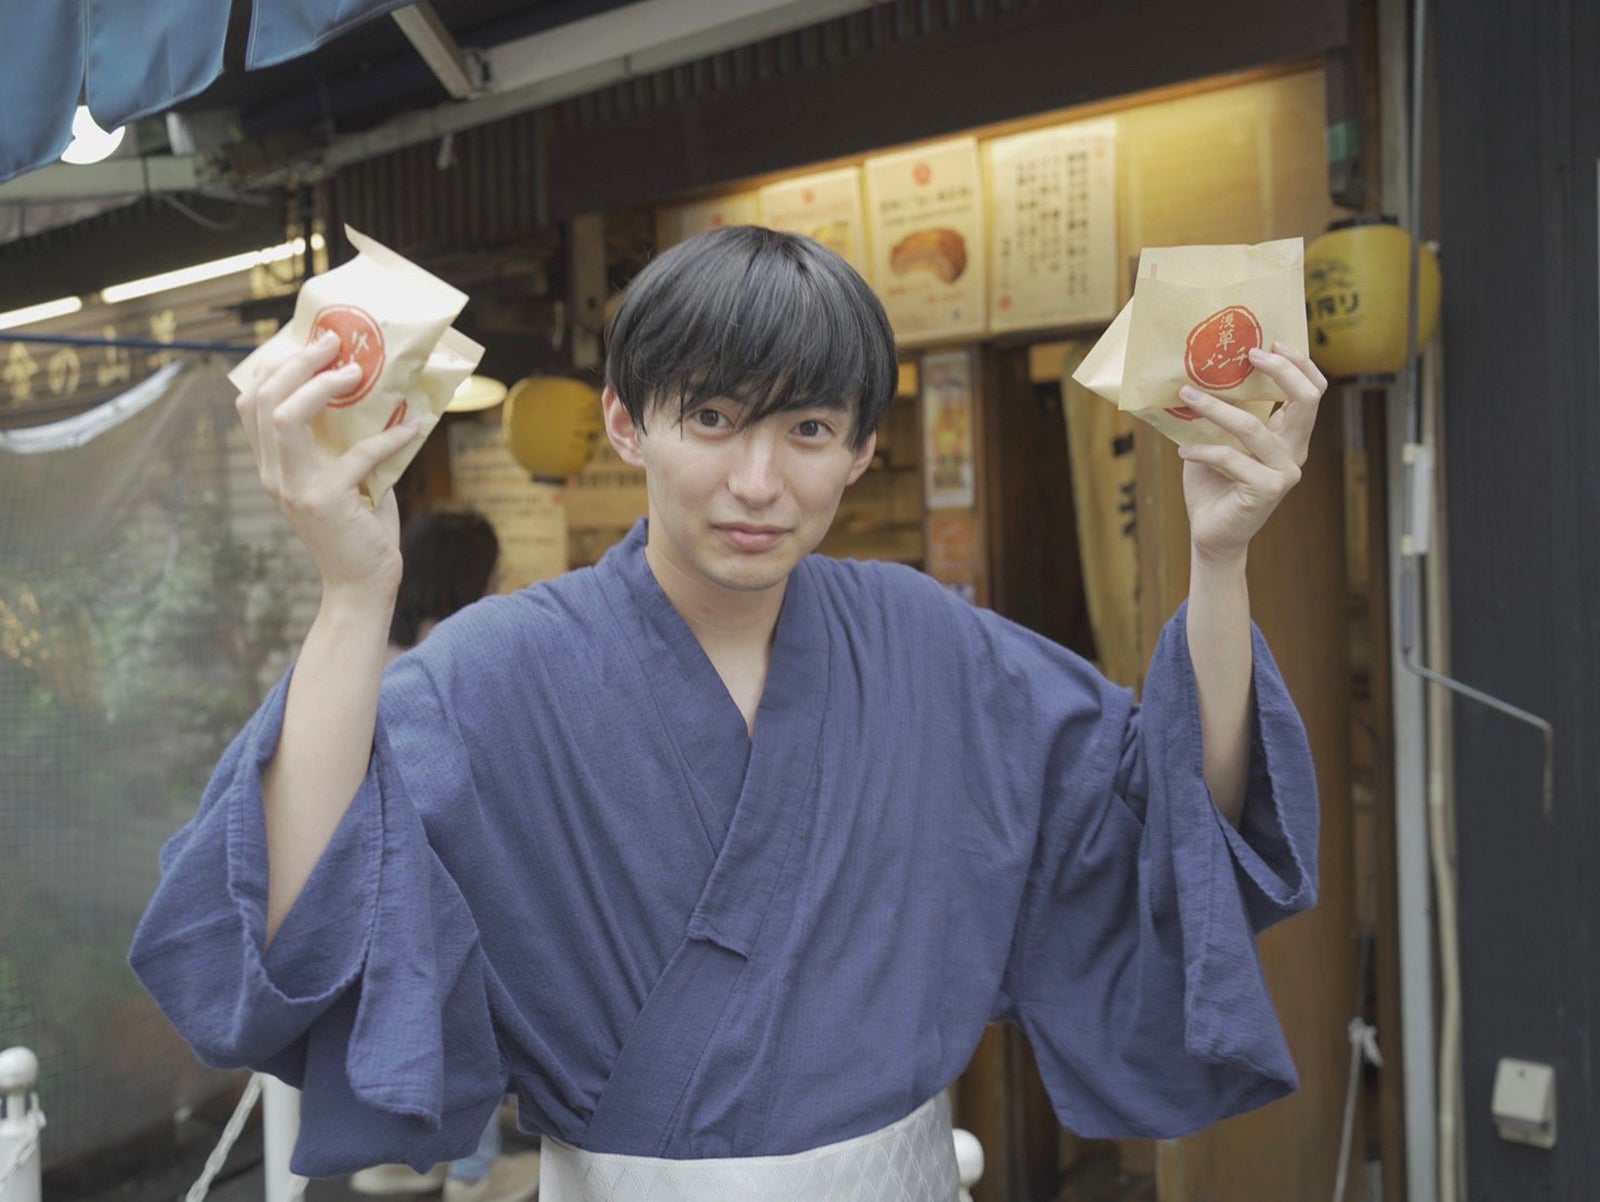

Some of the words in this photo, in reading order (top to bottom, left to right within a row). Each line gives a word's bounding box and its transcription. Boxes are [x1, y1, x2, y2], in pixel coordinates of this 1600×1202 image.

[1216, 312, 1236, 351] 浅草
[1201, 346, 1249, 372] メンチ
